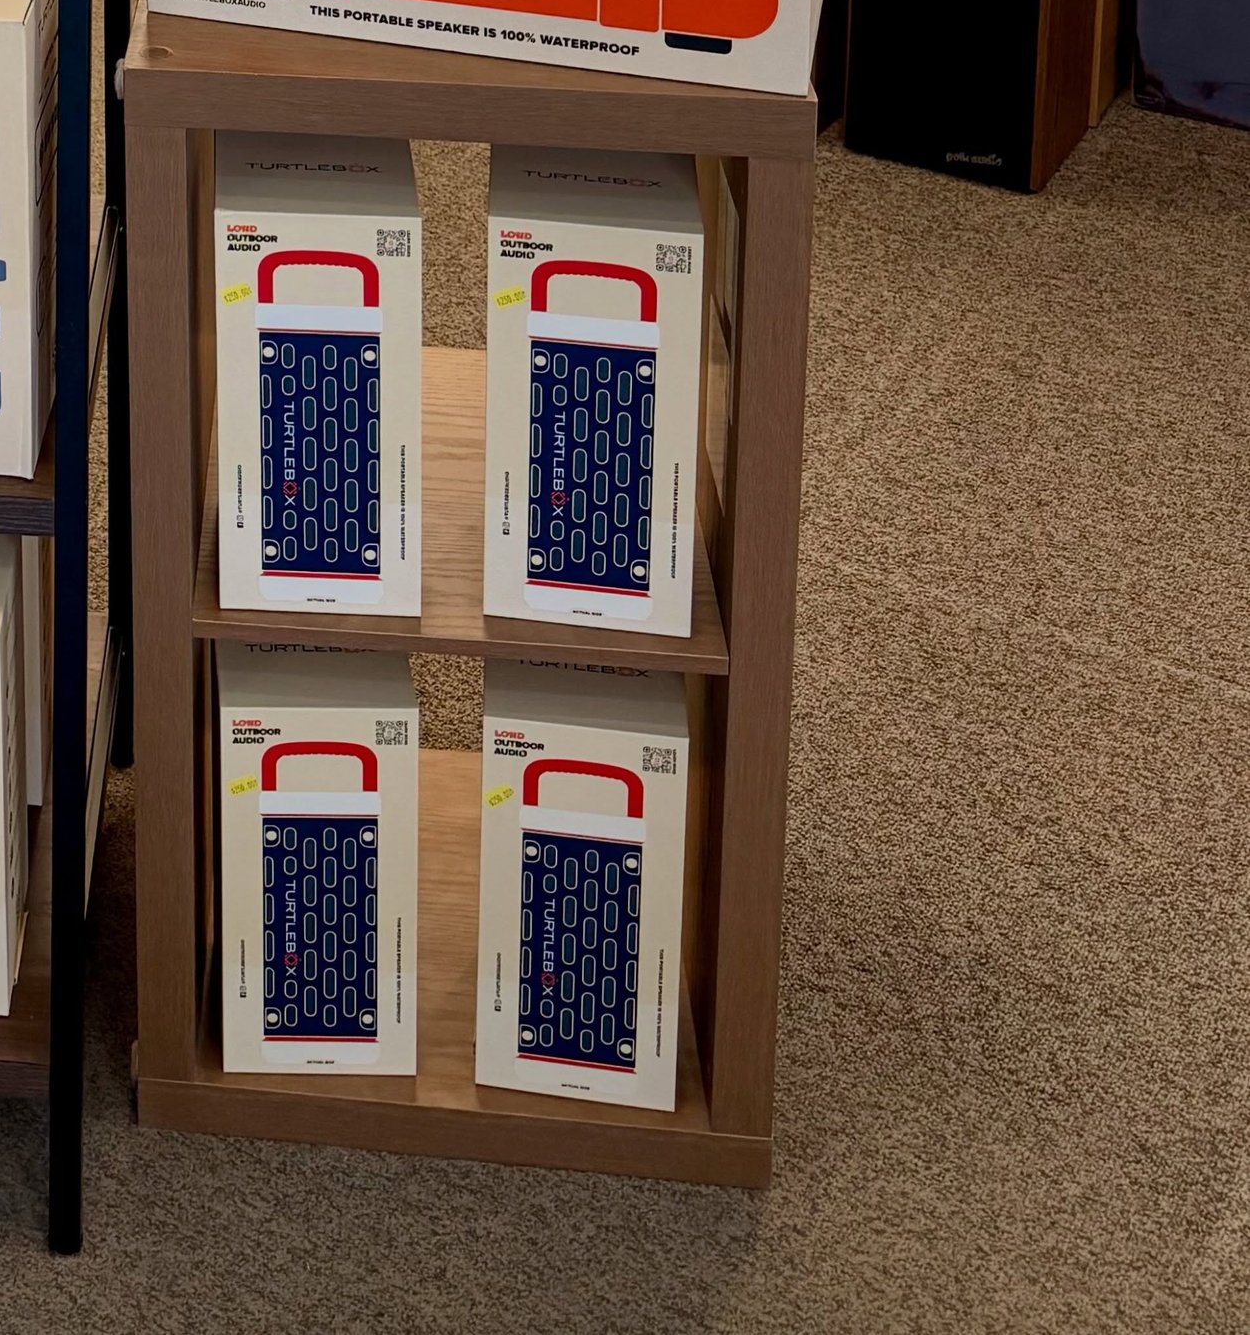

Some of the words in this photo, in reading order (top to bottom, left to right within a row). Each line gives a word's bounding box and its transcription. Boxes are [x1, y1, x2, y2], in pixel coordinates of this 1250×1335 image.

[310, 5, 340, 20] THIS
[343, 8, 413, 27] PORTABLE
[417, 17, 479, 36] SPEAKER
[483, 25, 496, 38] IS
[500, 28, 536, 43] 100%
[540, 33, 640, 56] WATERPROOF
[283, 401, 297, 506] TURTLEBOX
[551, 411, 567, 516] TURTLEBOX
[284, 879, 298, 976] TURTLEBOX
[541, 898, 557, 996] TURTLEBOX
